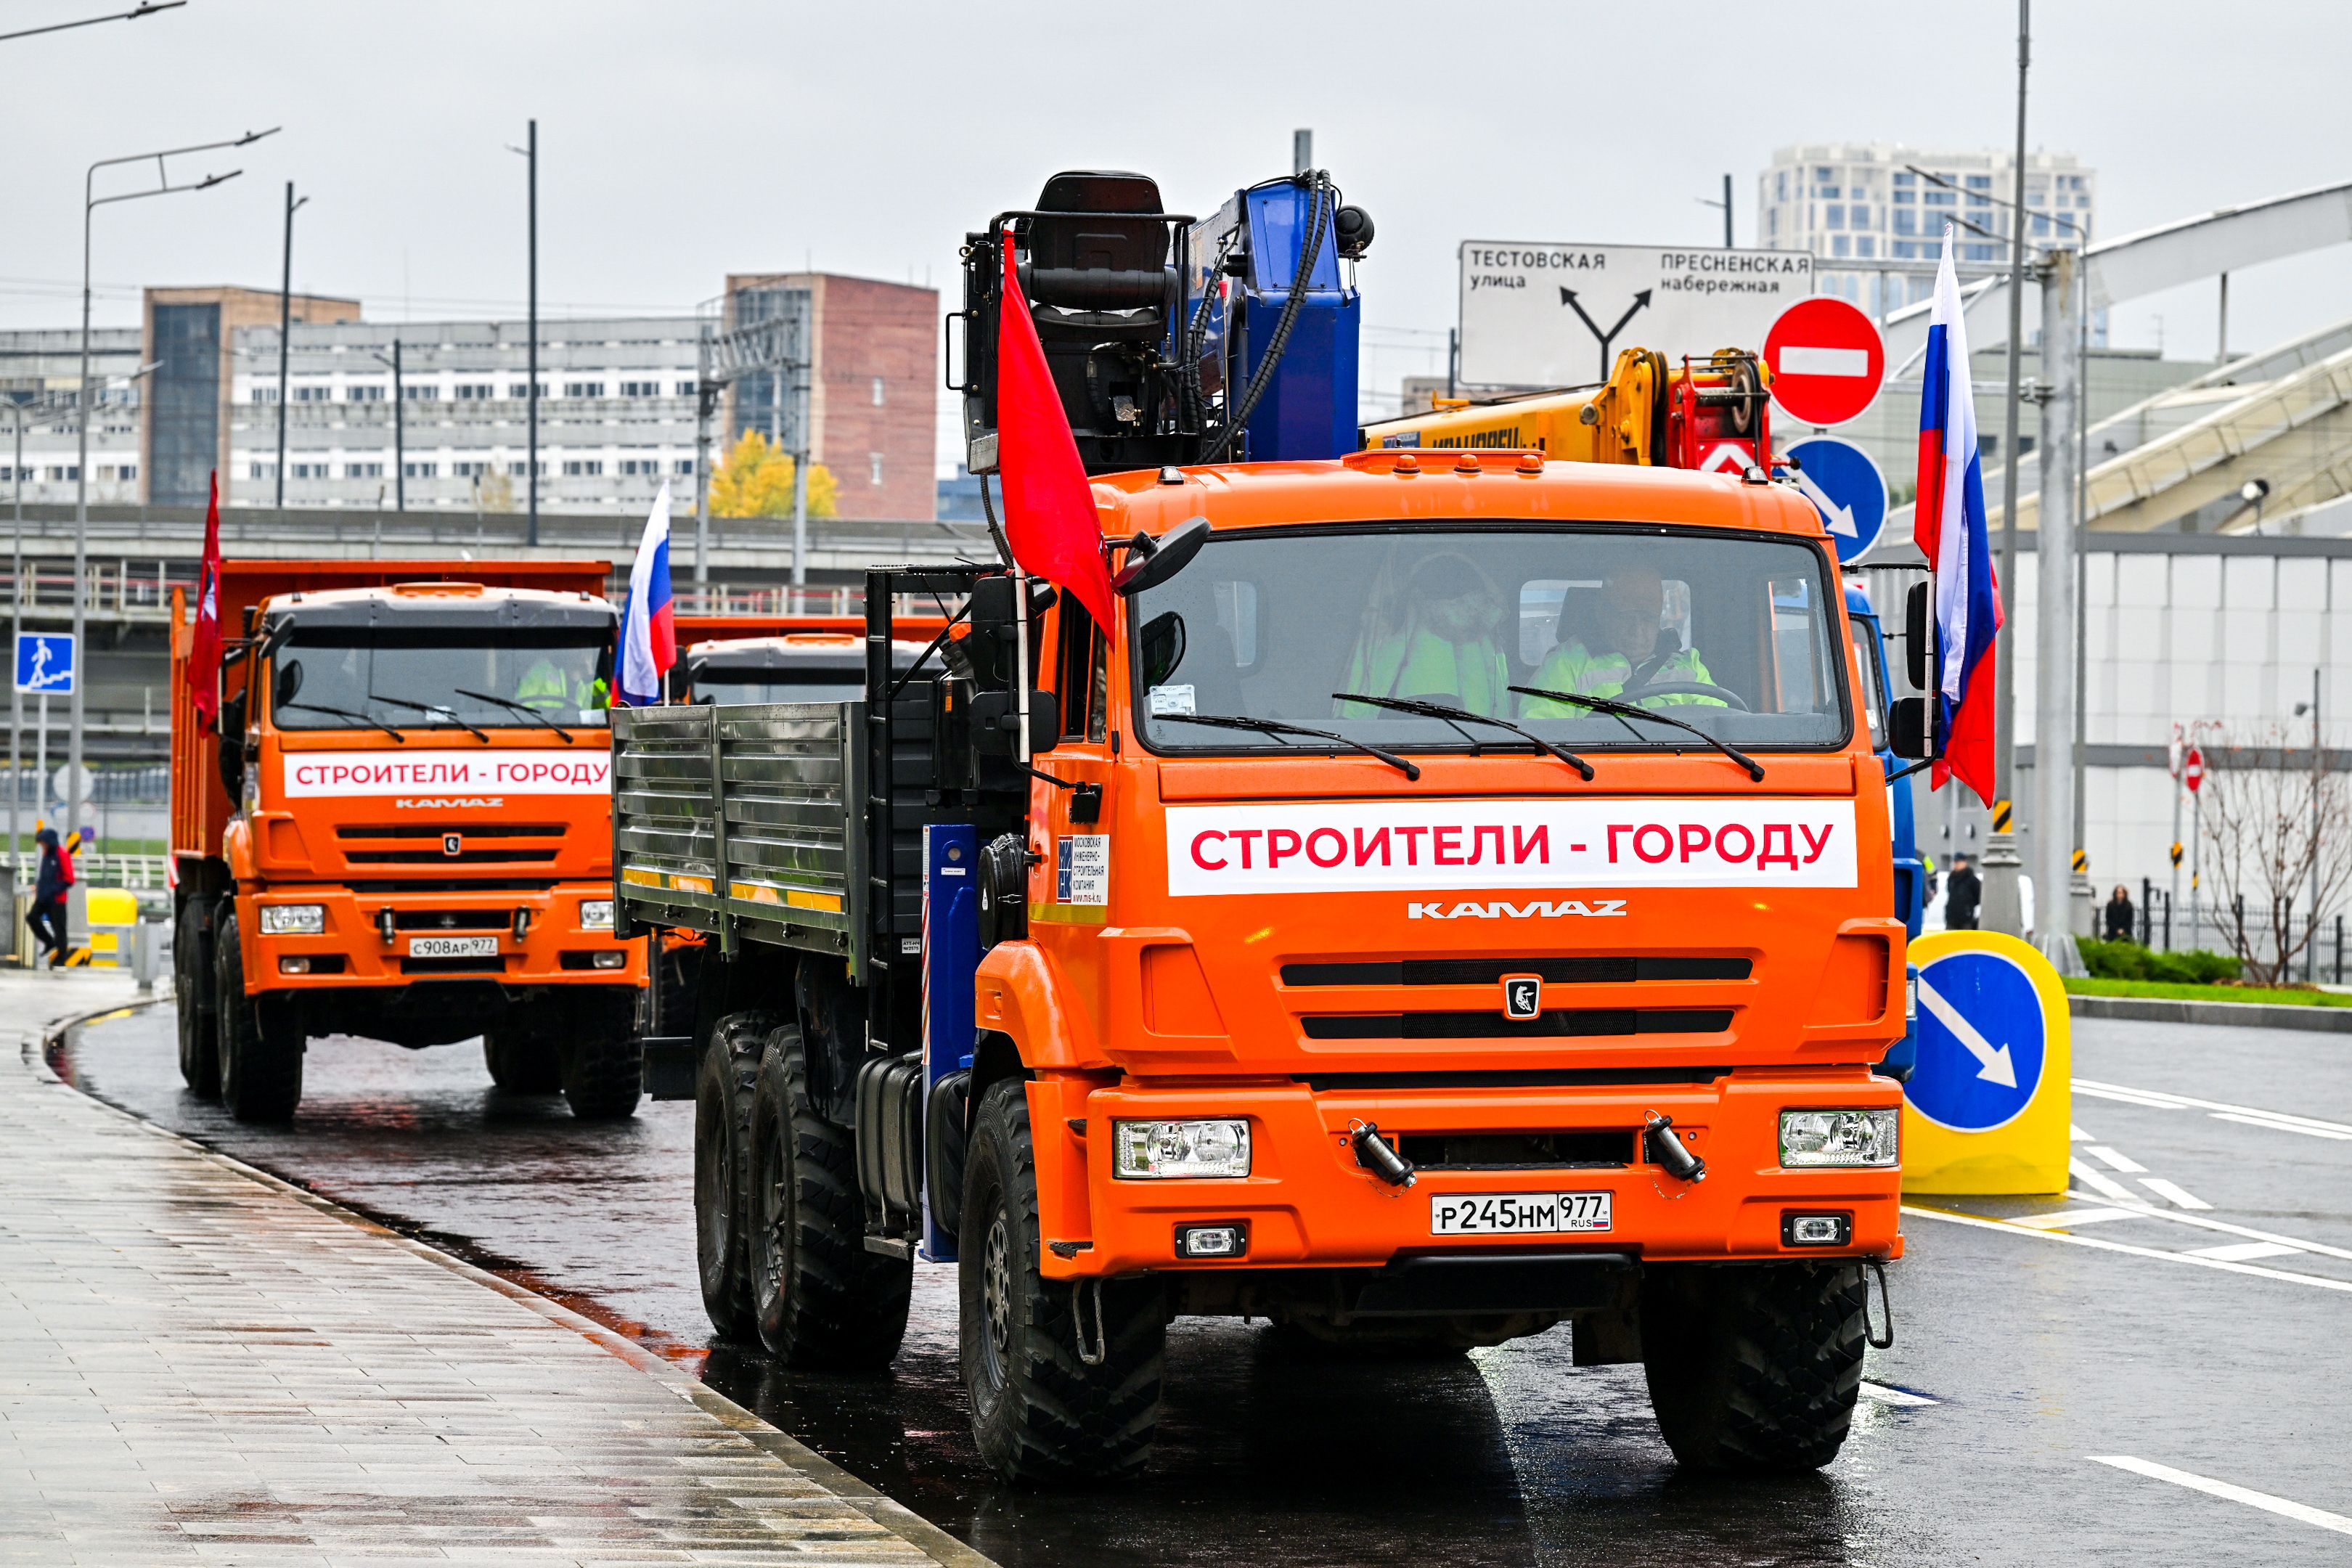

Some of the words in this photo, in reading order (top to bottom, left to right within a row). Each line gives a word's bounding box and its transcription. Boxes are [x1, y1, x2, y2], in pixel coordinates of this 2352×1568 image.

[1471, 250, 1606, 269] ТЕСТОВСКАЯ
[1661, 254, 1809, 274] ПРЕСНЕНСКАЯ
[1470, 273, 1527, 290] улица
[1661, 275, 1781, 295] набережная
[296, 764, 469, 784] СТРОИТЕЛИ
[497, 763, 608, 785] ГОРОДУ
[396, 798, 503, 808] KAMAZ
[1074, 837, 1101, 848] МОСКОВСКАЯ
[1191, 825, 1550, 870] СТРОИТЕЛИ
[1606, 823, 1834, 870] ГОРОДУ
[1074, 852, 1101, 862] ИНЖЕНЕРНО-
[1073, 865, 1104, 876] СТРОИТЕЛЬНАЯ
[1073, 880, 1095, 890] КОМПАНИЯ
[1073, 893, 1101, 902] www.mis-k.ru
[1408, 900, 1627, 919] KAMAZ
[414, 941, 468, 954] С908АР
[472, 939, 493, 950] 977
[1441, 1199, 1554, 1229] Р245НМ
[1560, 1196, 1602, 1218] 977
